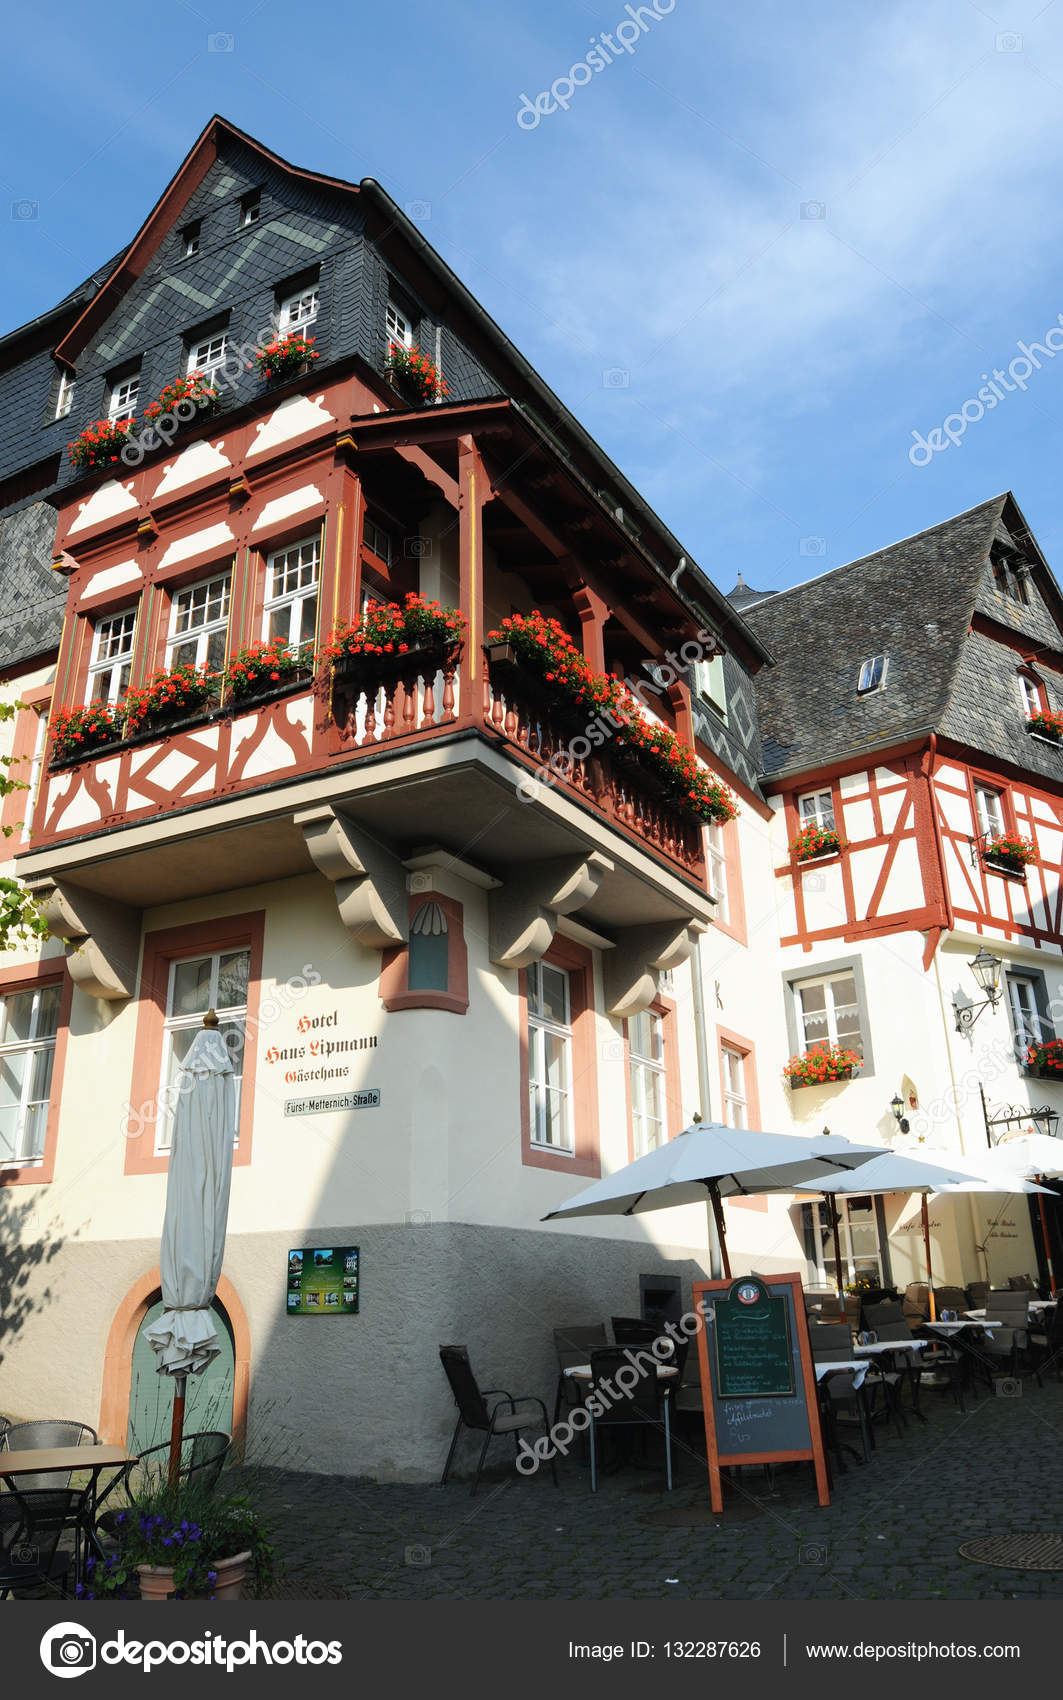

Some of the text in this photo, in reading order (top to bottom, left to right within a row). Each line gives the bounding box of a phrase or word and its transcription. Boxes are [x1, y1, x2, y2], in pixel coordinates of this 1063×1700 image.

[296, 1010, 338, 1033] Hotel
[265, 1035, 378, 1065] Haus Lipmann
[285, 1065, 350, 1084] Gästehaus
[286, 1092, 378, 1114] Fürst-Metternich-Straße
